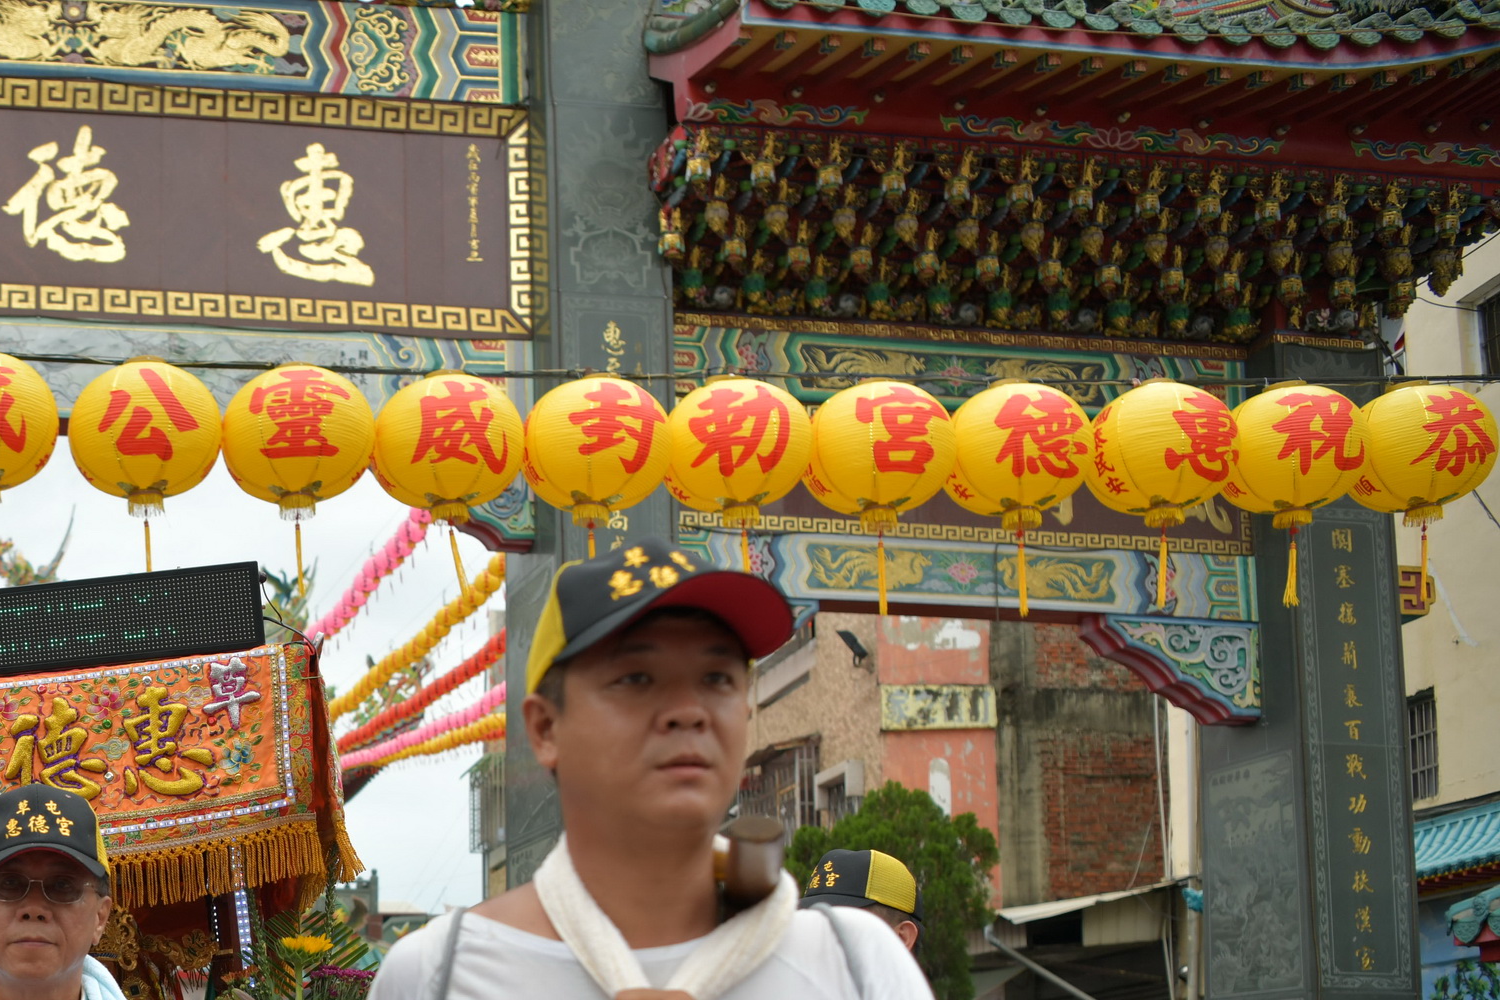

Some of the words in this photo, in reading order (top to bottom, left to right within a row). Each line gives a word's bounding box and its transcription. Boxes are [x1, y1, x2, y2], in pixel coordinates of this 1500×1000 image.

[98, 368, 200, 461] 公
[249, 369, 350, 459] 靈
[411, 382, 508, 475] 威
[568, 382, 668, 475] 封
[855, 386, 950, 474] 宮
[994, 391, 1088, 479] 德
[1164, 393, 1240, 483] 惠
[1272, 393, 1365, 477] 祝
[1411, 393, 1495, 477] 恭
[203, 656, 261, 730] 草
[4, 814, 75, 839] 惠德宮
[15, 799, 62, 816] 草屯
